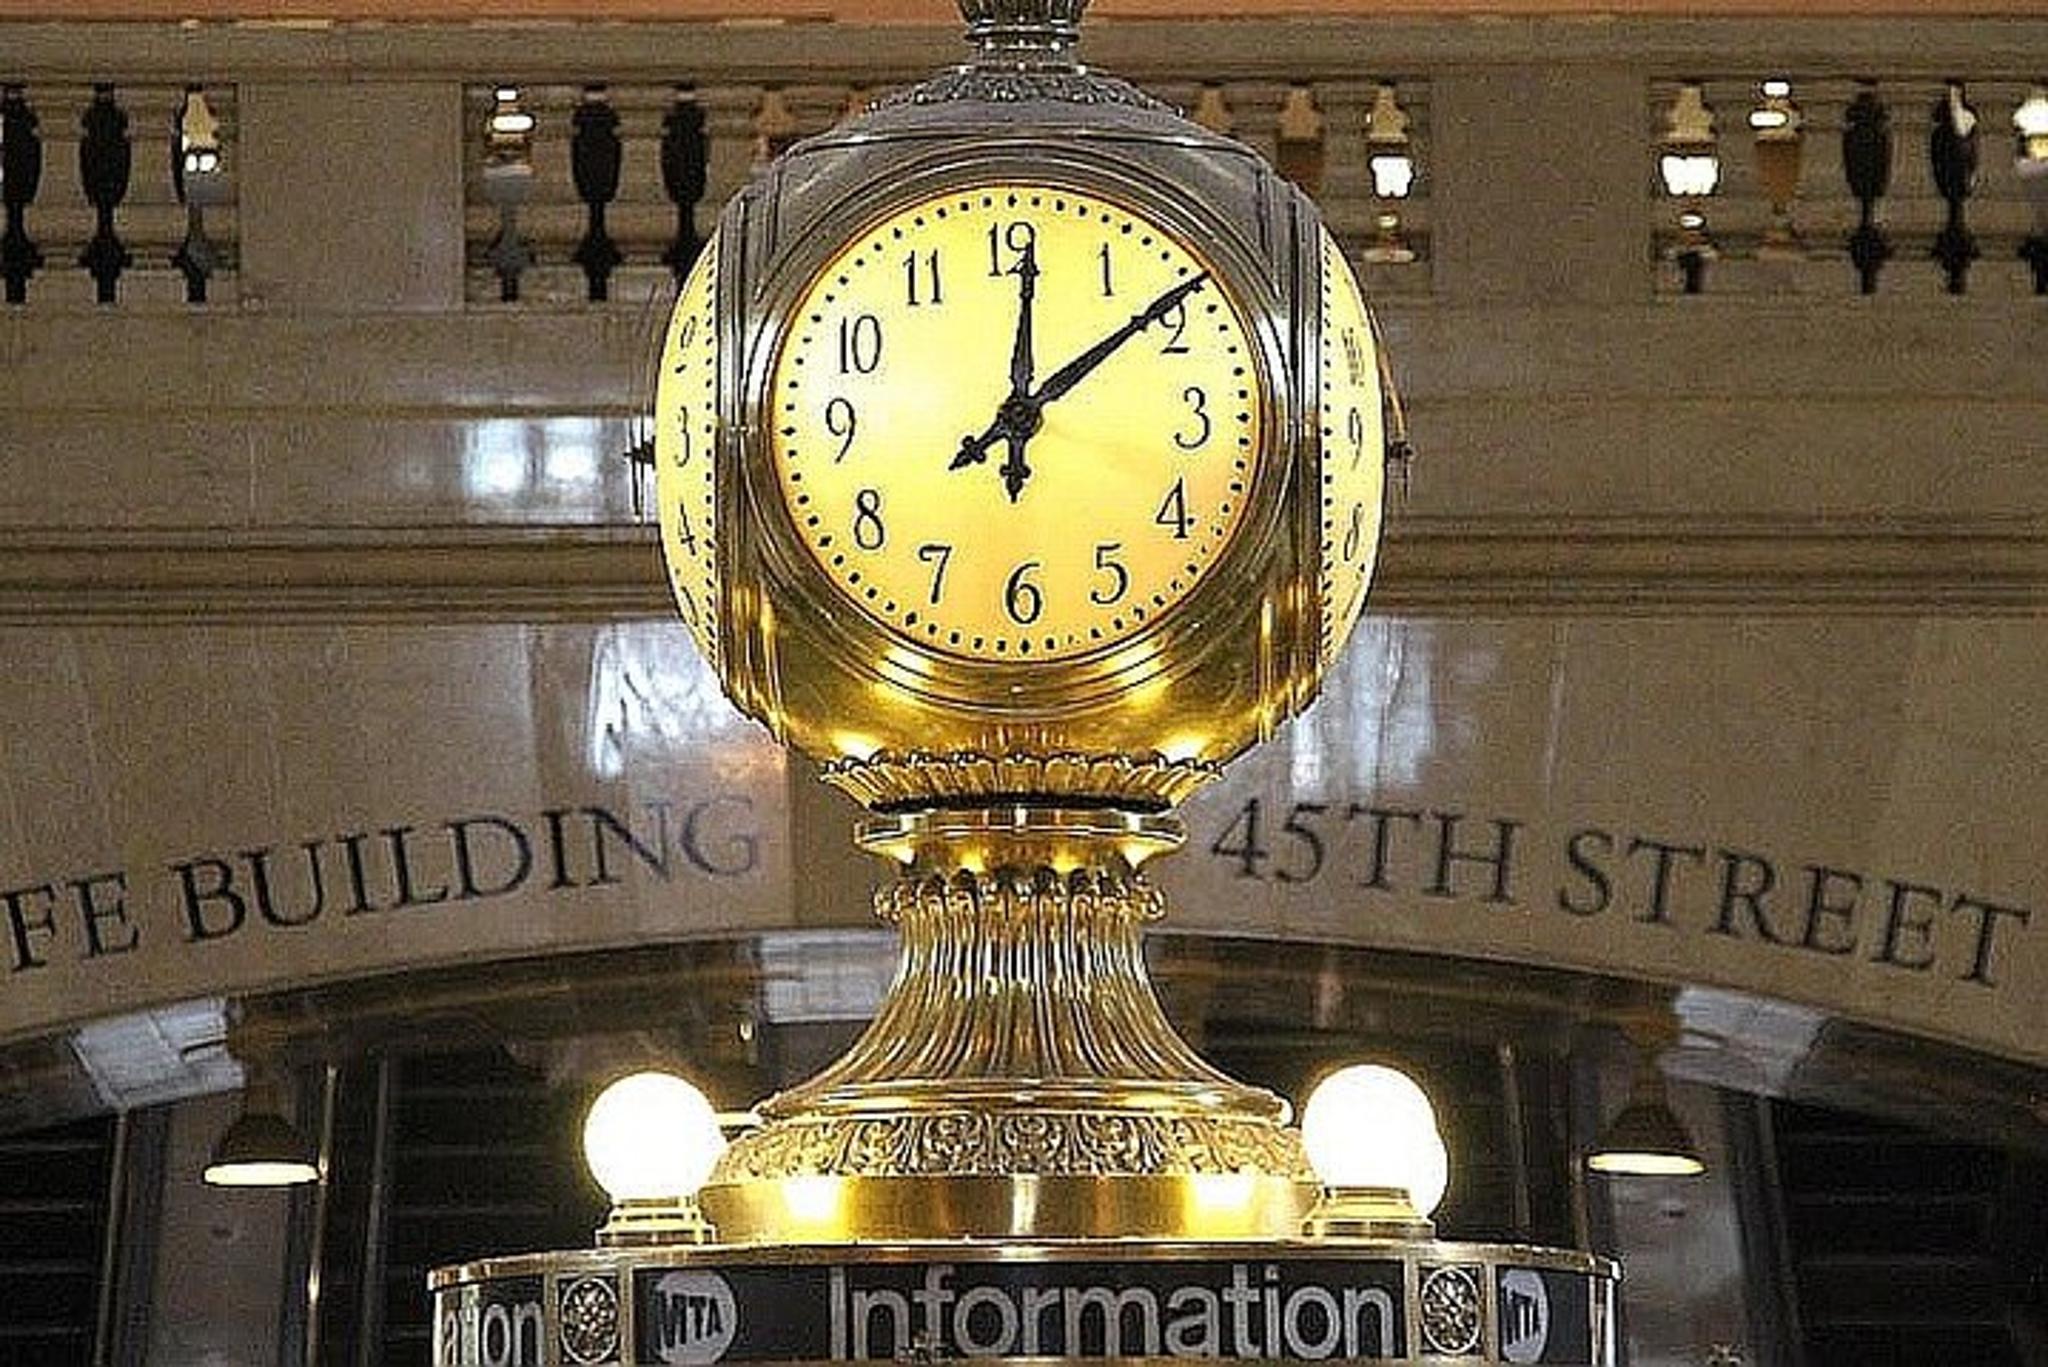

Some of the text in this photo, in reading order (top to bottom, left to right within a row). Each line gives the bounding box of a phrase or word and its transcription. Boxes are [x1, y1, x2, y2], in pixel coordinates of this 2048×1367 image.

[903, 249, 942, 306] 11
[1099, 242, 1113, 297] 1
[838, 315, 882, 375] 10
[1159, 299, 1190, 354] 2
[825, 398, 856, 463] 9
[1174, 386, 1211, 450] 3
[854, 489, 884, 550] 8
[1156, 477, 1195, 539] 4
[919, 544, 952, 604] 7
[1006, 563, 1042, 625] 6
[1091, 543, 1129, 604] 5
[169, 796, 760, 944] BUILDING
[1210, 798, 2032, 987] 45TH STREET
[828, 1263, 1394, 1361] Information
